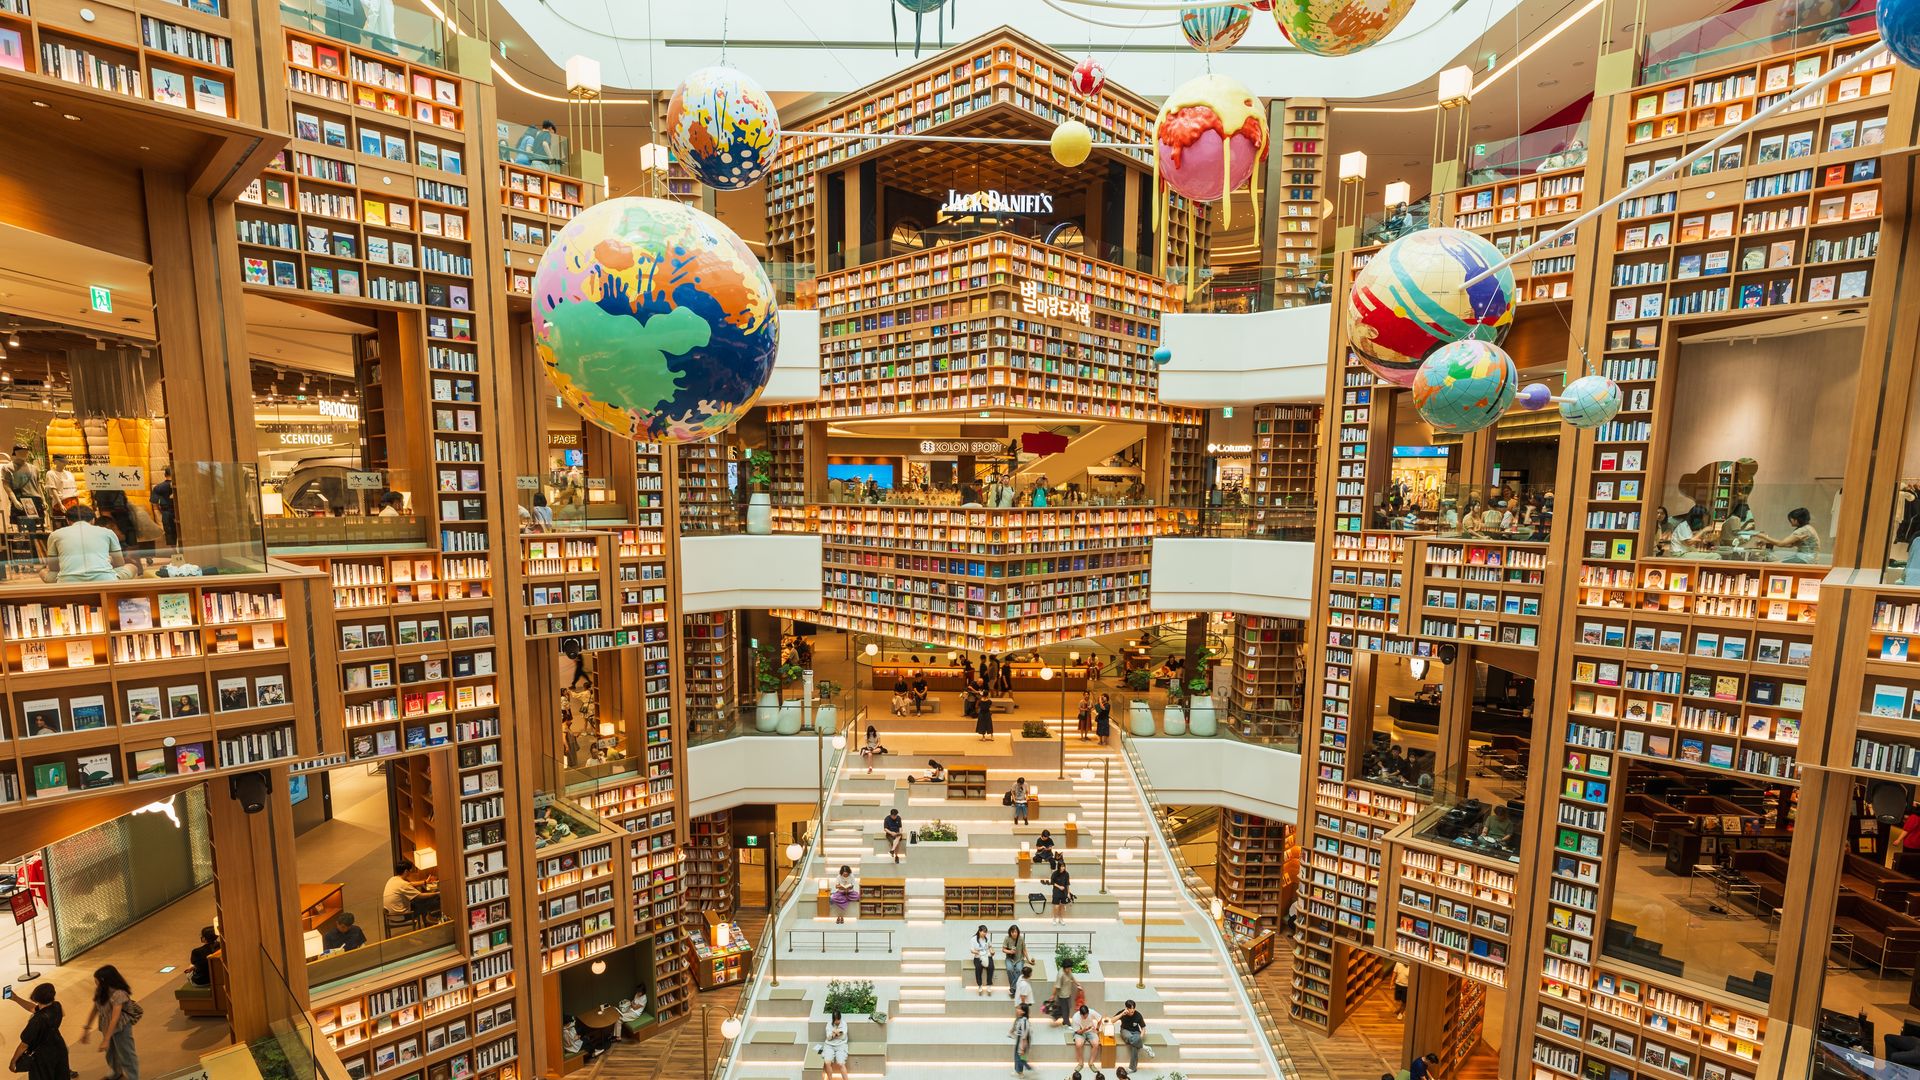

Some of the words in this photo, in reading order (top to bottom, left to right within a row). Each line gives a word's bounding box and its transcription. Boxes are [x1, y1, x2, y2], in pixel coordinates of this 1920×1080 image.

[942, 189, 982, 212] JACK
[988, 190, 1053, 213] DANIEL'S
[1020, 281, 1090, 323] 별마당도서관
[280, 434, 333, 445] SCENTIQUE
[553, 434, 577, 445] FACE
[935, 442, 968, 453] KOLON
[971, 442, 1002, 453] SPORT
